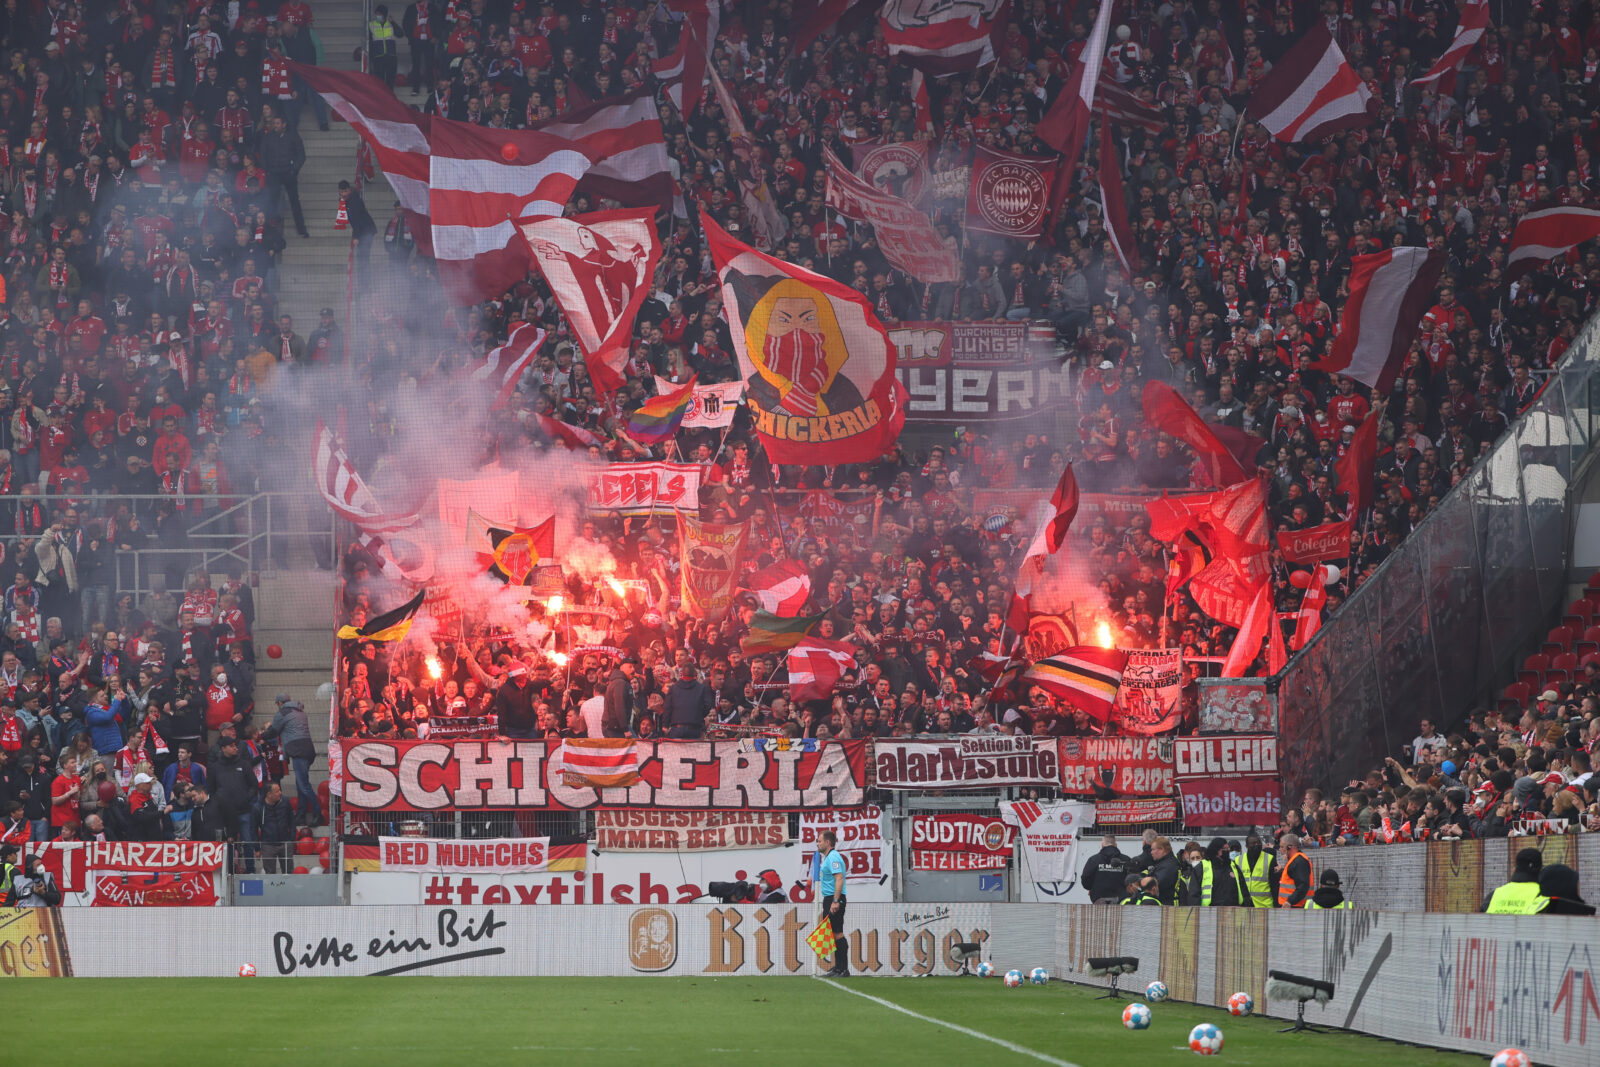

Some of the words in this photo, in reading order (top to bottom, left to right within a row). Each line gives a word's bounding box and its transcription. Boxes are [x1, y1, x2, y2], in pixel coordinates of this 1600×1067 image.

[1293, 535, 1340, 554] Colegio
[961, 738, 1013, 754] Sektion
[1174, 738, 1278, 774] COLEGIO
[1121, 767, 1174, 794] PRIDE
[1185, 791, 1281, 814] Rhoibazis
[597, 808, 786, 828] AUSGESPERRTE
[802, 809, 836, 824] WIR
[838, 806, 881, 822] SIND
[598, 829, 680, 850] IMMER
[687, 829, 727, 849] BEI
[733, 825, 784, 846] UNS
[843, 823, 881, 842] DIR
[93, 841, 224, 867] HARZBURG
[385, 842, 429, 865] RED
[911, 850, 966, 870] LETZTE
[273, 931, 358, 975] Bitte
[367, 929, 432, 957] ein
[438, 908, 507, 947] Bit
[703, 906, 991, 975] Biturger
